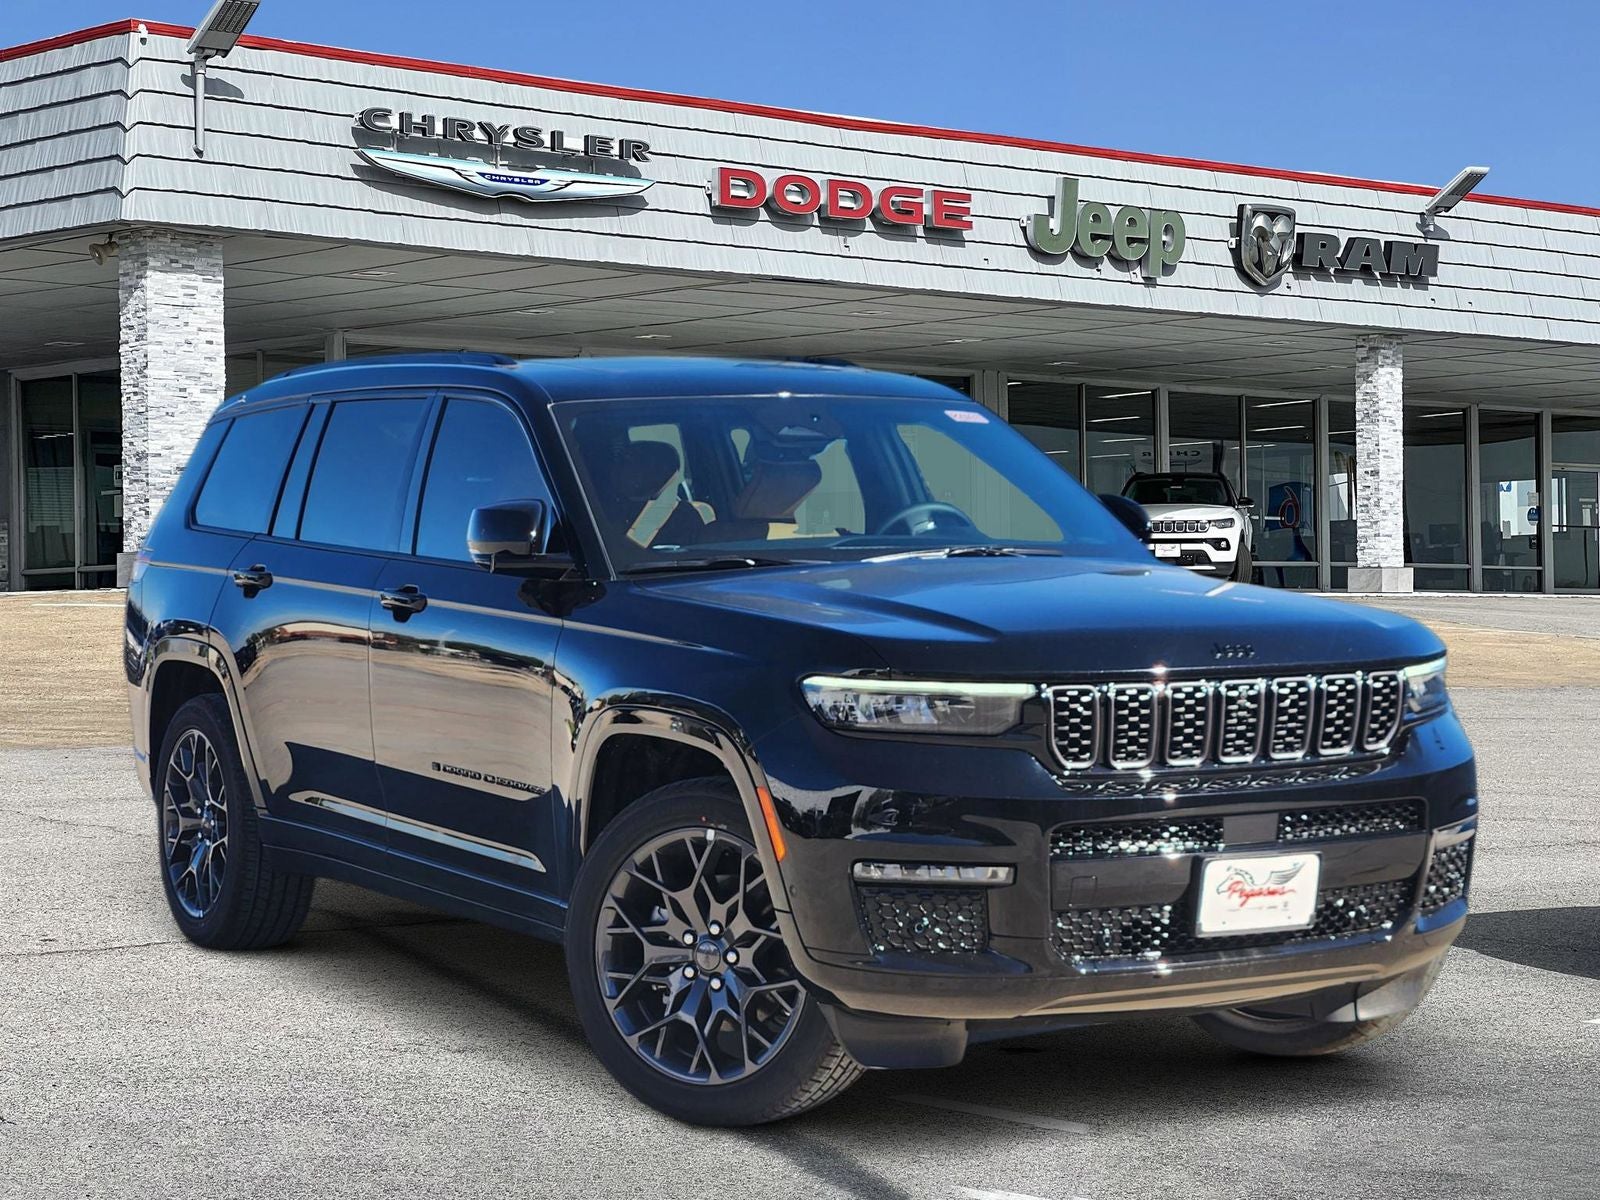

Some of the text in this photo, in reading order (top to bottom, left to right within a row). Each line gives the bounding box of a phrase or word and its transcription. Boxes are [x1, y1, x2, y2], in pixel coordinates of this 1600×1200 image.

[352, 106, 652, 162] CHRYSLER
[484, 174, 541, 185] CHRYSLER
[712, 166, 973, 230] DODGE
[1024, 176, 1186, 279] Jeep
[1297, 232, 1439, 278] RAM
